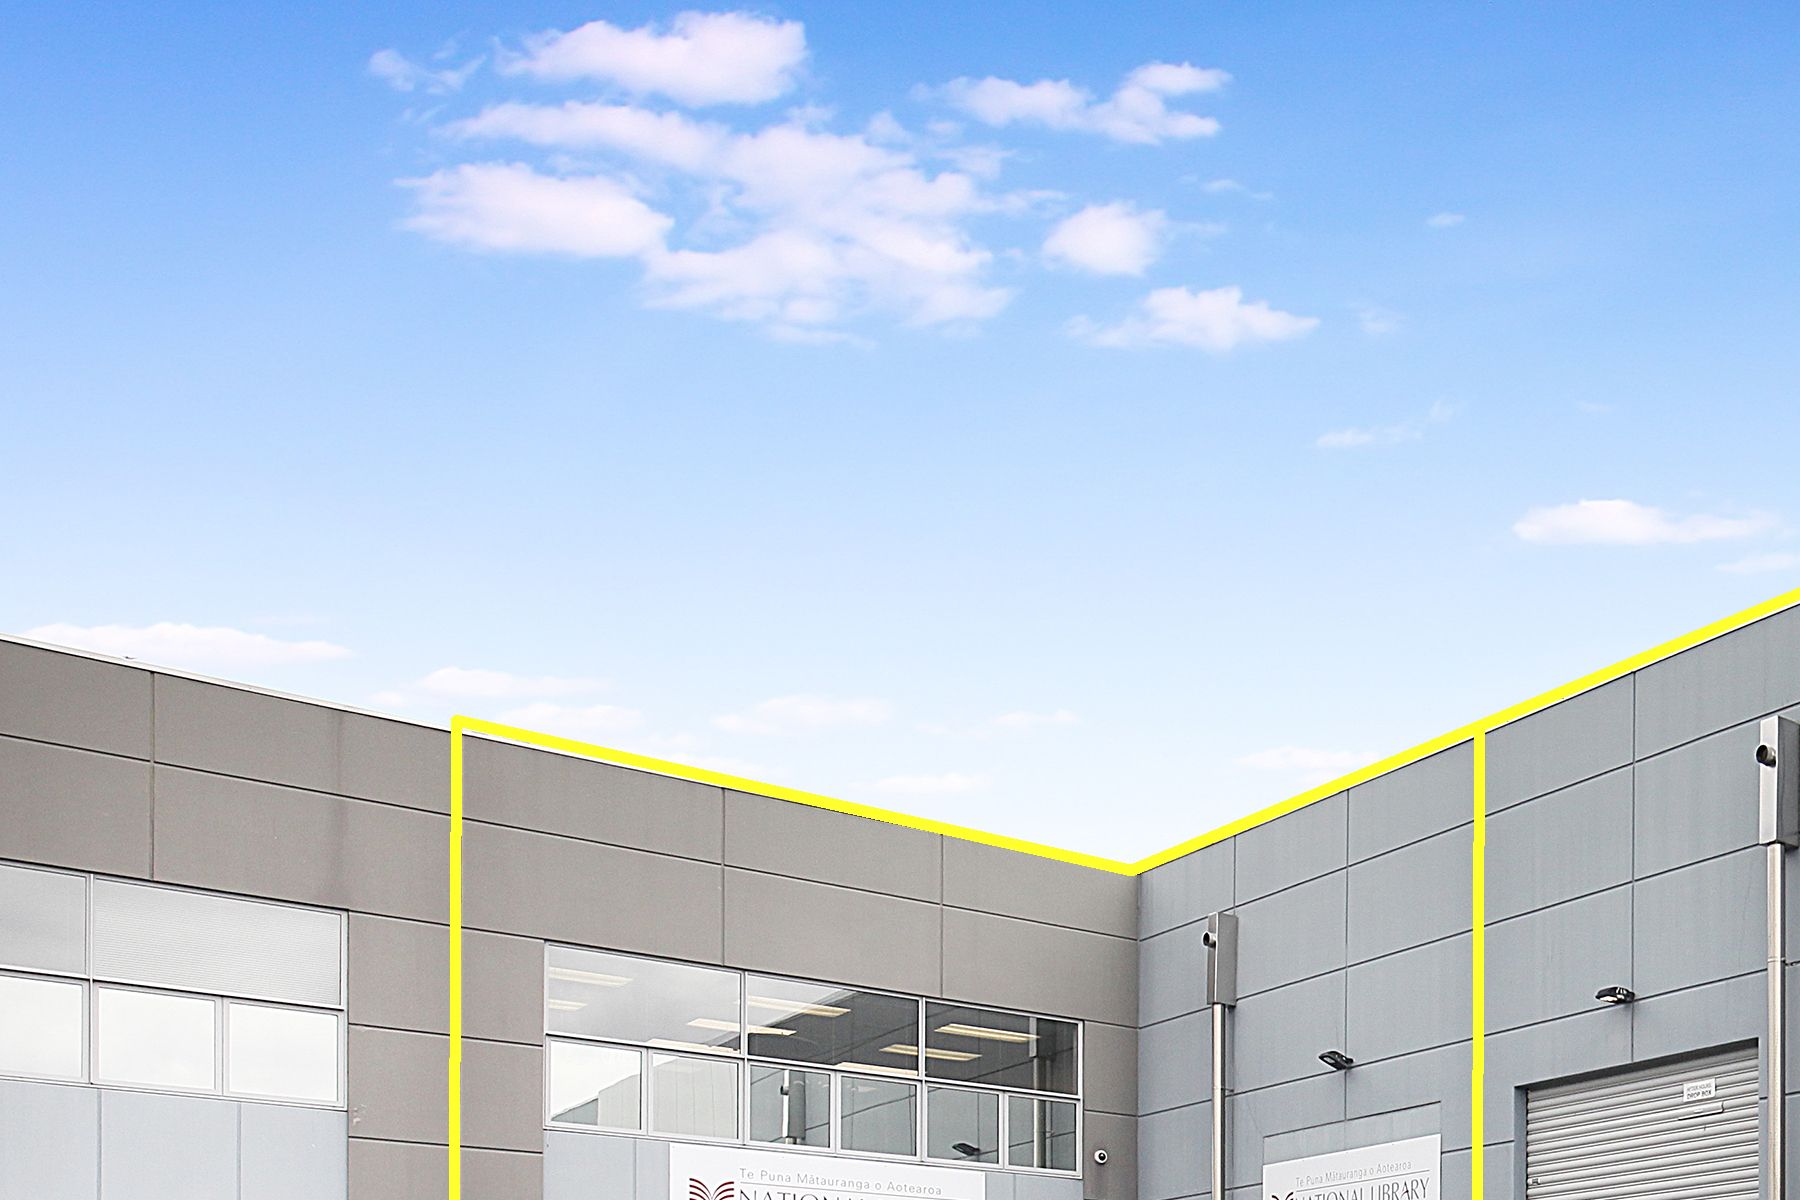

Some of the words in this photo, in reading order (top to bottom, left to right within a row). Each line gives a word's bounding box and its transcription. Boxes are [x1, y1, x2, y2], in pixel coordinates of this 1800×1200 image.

[739, 1168, 755, 1180] Te
[760, 1170, 791, 1183] Puna
[875, 1182, 882, 1191] o
[887, 1181, 942, 1196] Aotearoa
[1296, 1177, 1305, 1188] Te
[1306, 1175, 1324, 1186] Puna
[1377, 1161, 1412, 1174] Aotearoa
